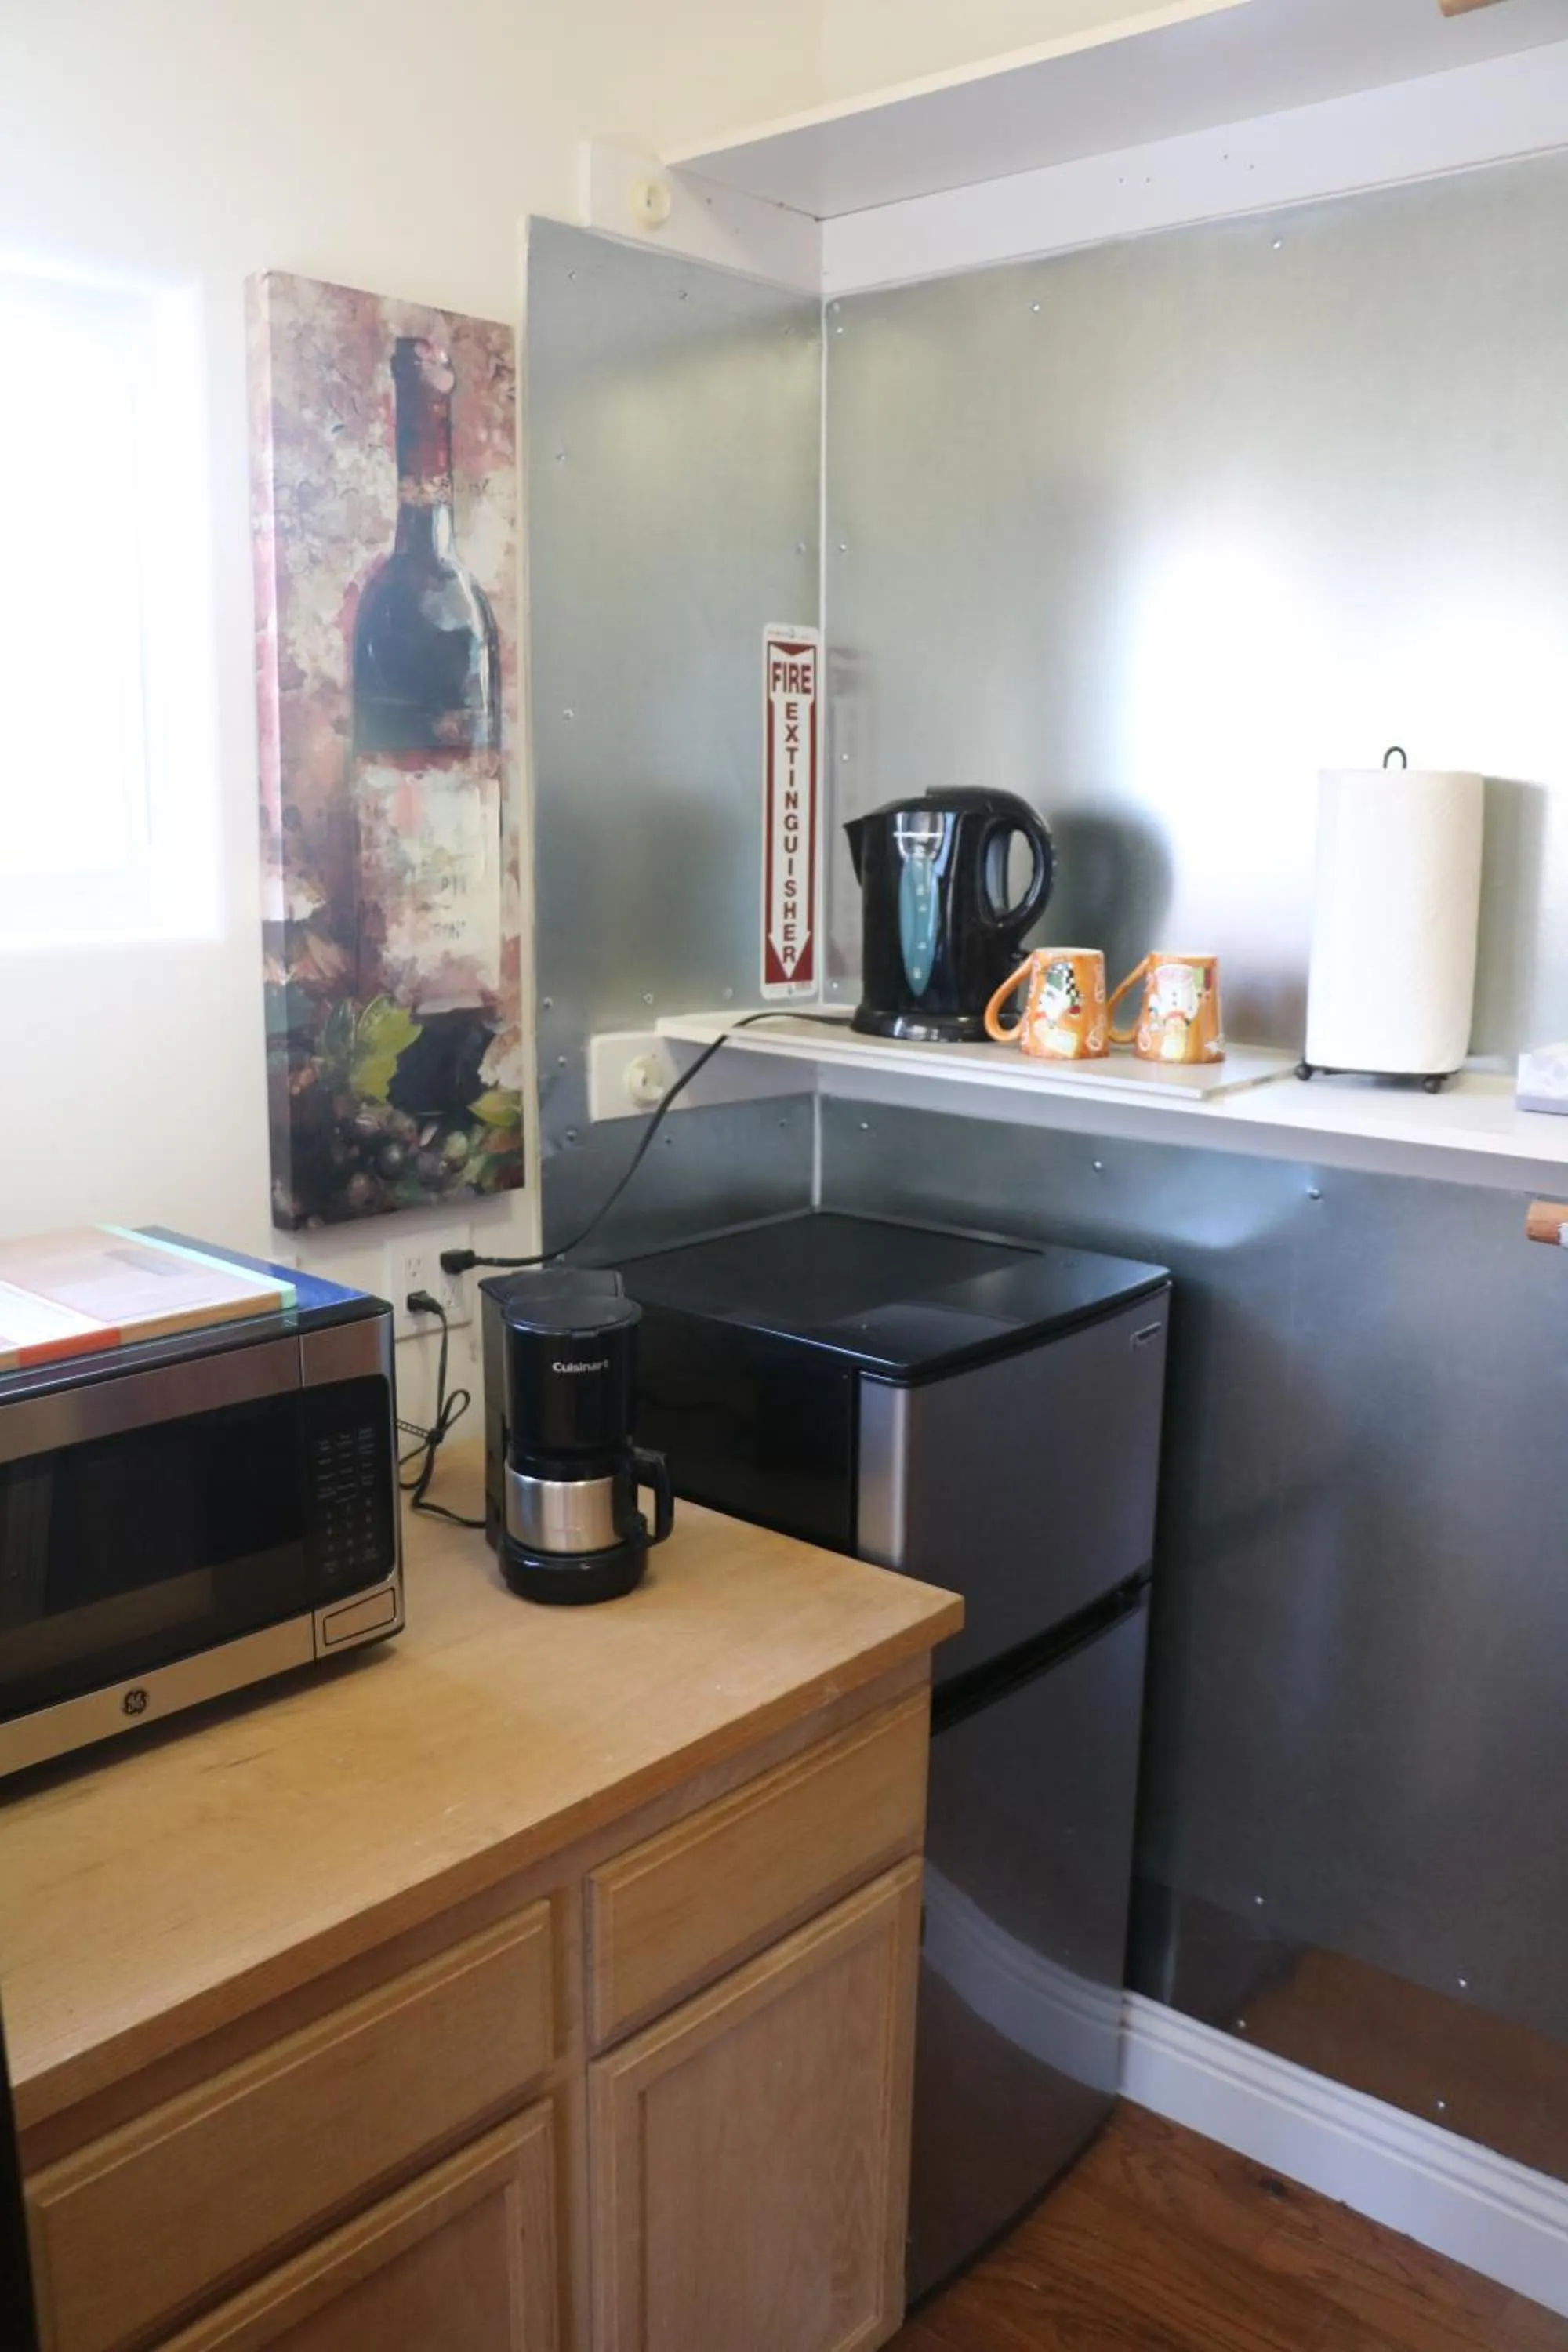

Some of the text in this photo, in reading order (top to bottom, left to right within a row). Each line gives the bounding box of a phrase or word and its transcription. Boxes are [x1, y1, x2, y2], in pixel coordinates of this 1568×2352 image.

[772, 662, 811, 695] FIRE
[783, 702, 800, 963] EXTINGUISHER
[552, 1359, 608, 1373] Cuisinart
